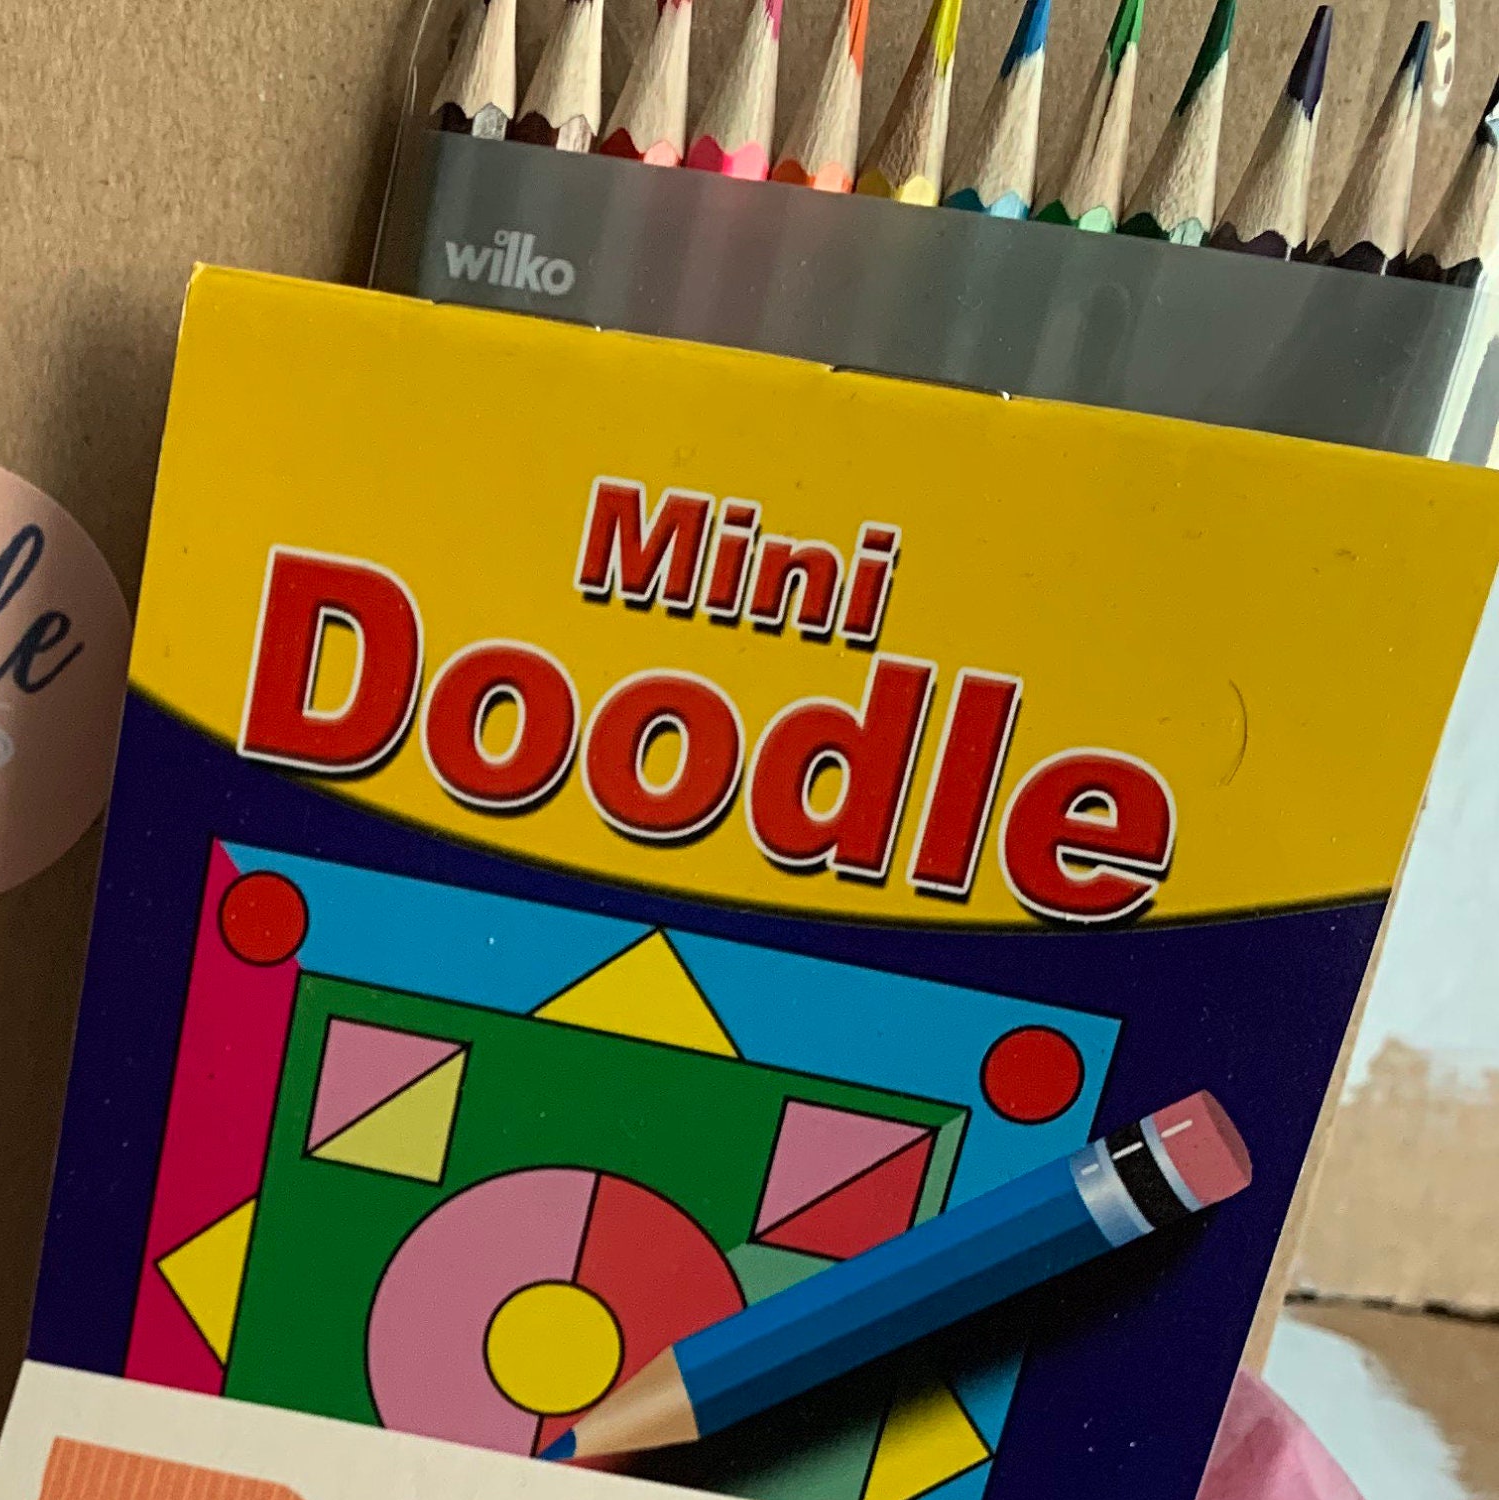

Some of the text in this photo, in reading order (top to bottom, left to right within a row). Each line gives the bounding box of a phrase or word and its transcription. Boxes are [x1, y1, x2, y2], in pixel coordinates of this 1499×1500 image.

[445, 229, 576, 296] wilko
[574, 476, 902, 653] Mini
[236, 545, 1178, 926] Doodle
